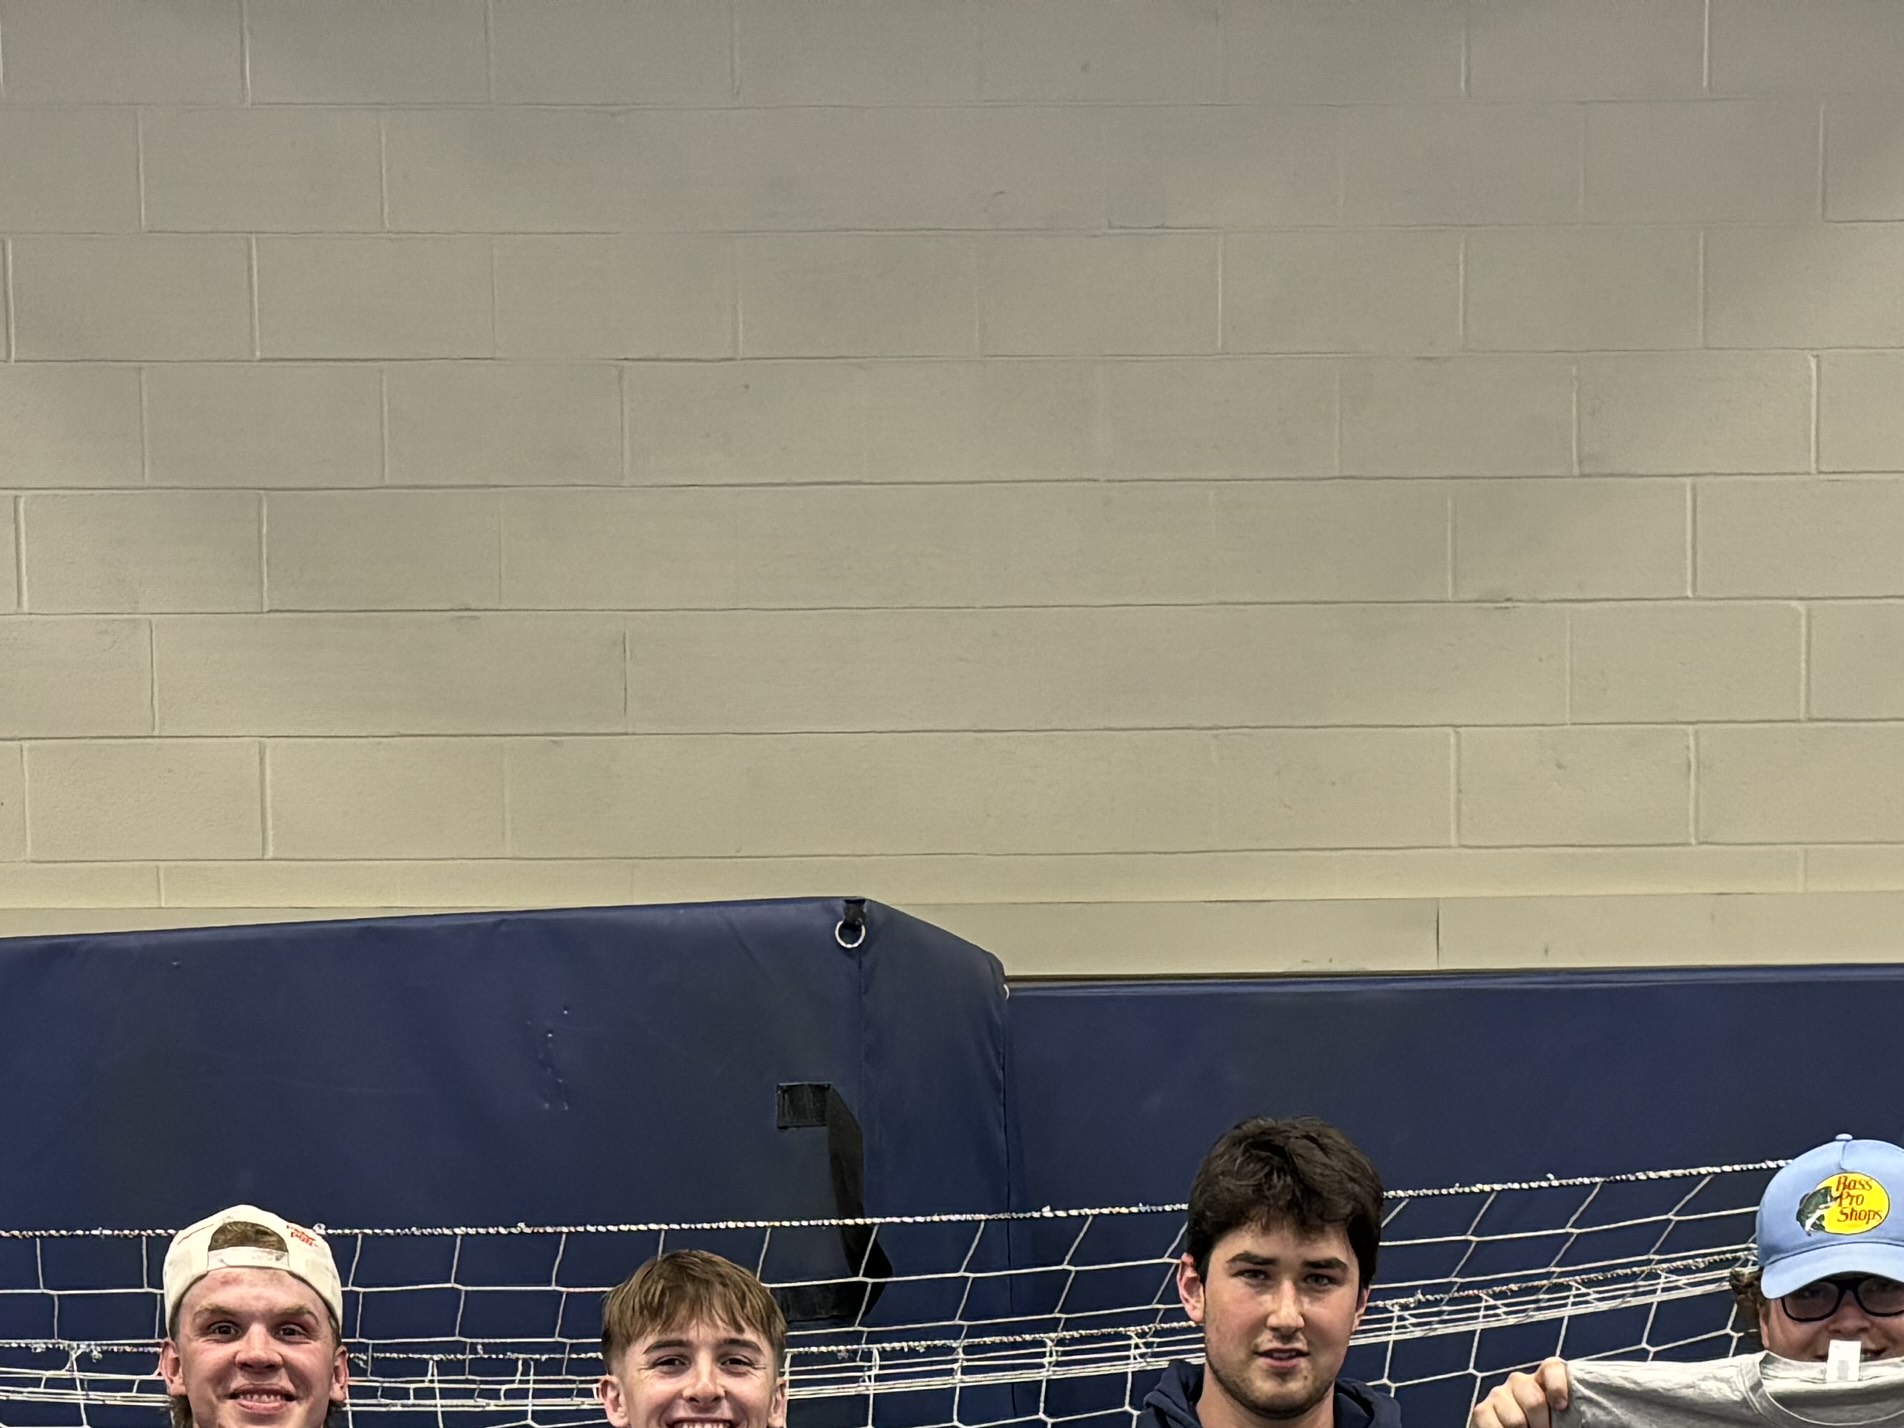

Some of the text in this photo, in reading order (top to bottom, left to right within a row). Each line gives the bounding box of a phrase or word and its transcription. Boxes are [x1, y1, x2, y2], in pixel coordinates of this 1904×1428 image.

[1836, 1175, 1873, 1192] Bass
[1837, 1191, 1865, 1208] Pro
[1837, 1206, 1883, 1225] Shops
